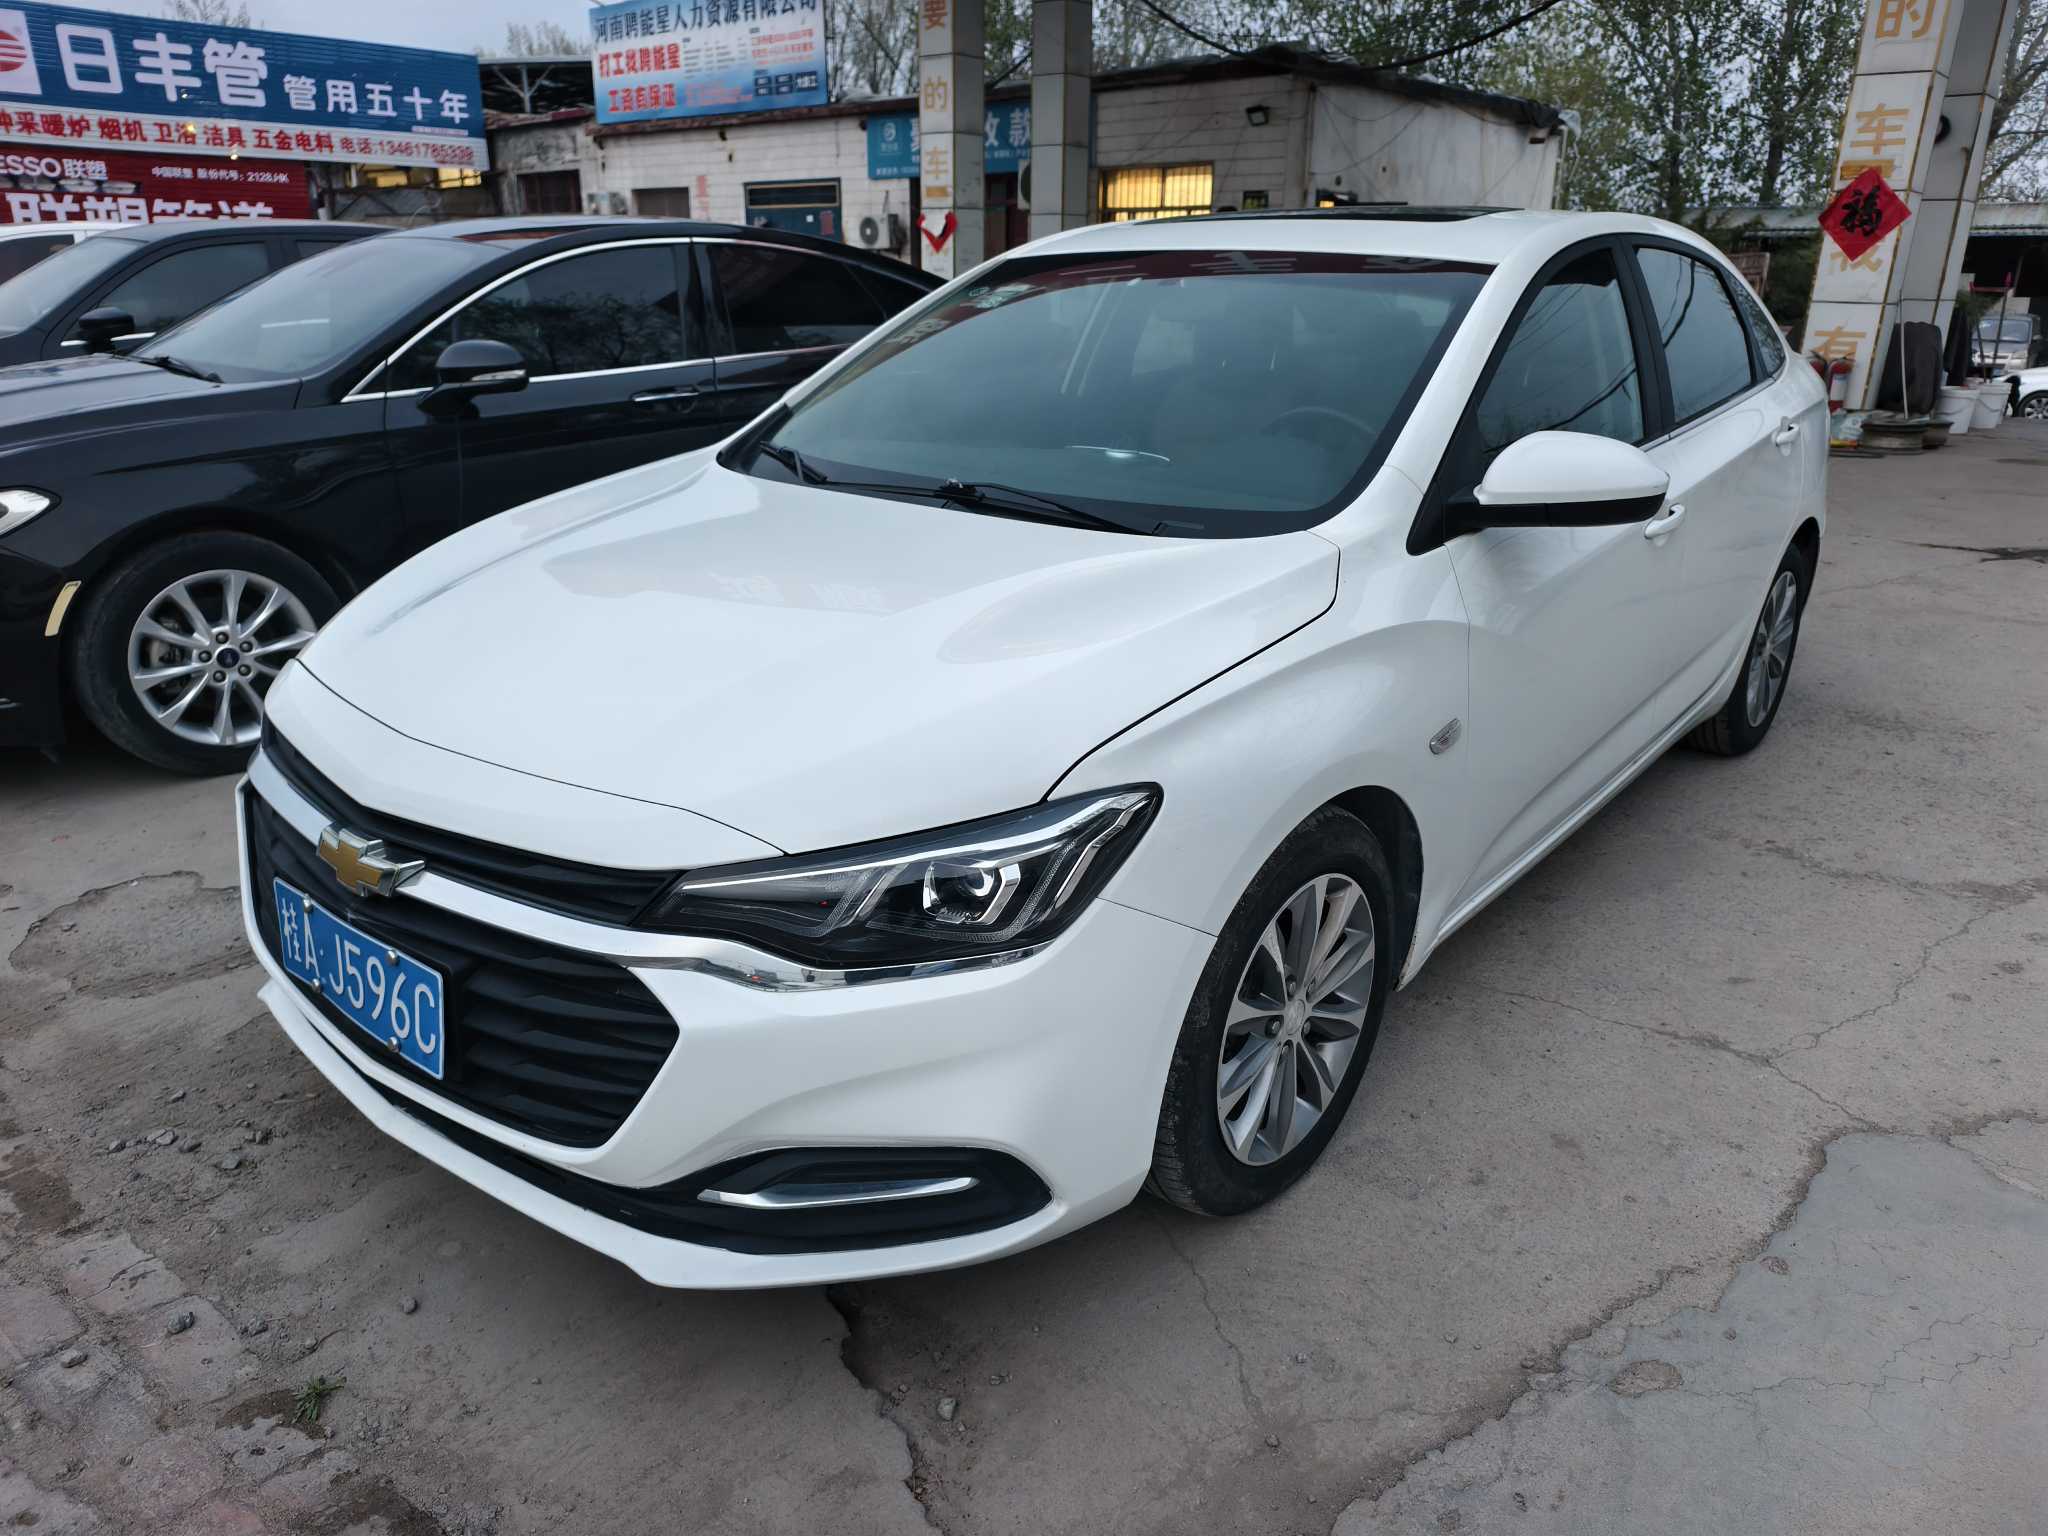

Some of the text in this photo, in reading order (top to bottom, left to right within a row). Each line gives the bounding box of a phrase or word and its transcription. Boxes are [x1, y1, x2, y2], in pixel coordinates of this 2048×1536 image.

[55, 23, 470, 124] 日丰管 管用五十年
[97, 117, 147, 142] 烟机
[203, 123, 247, 148] 洁具
[253, 129, 334, 152] 五金电料
